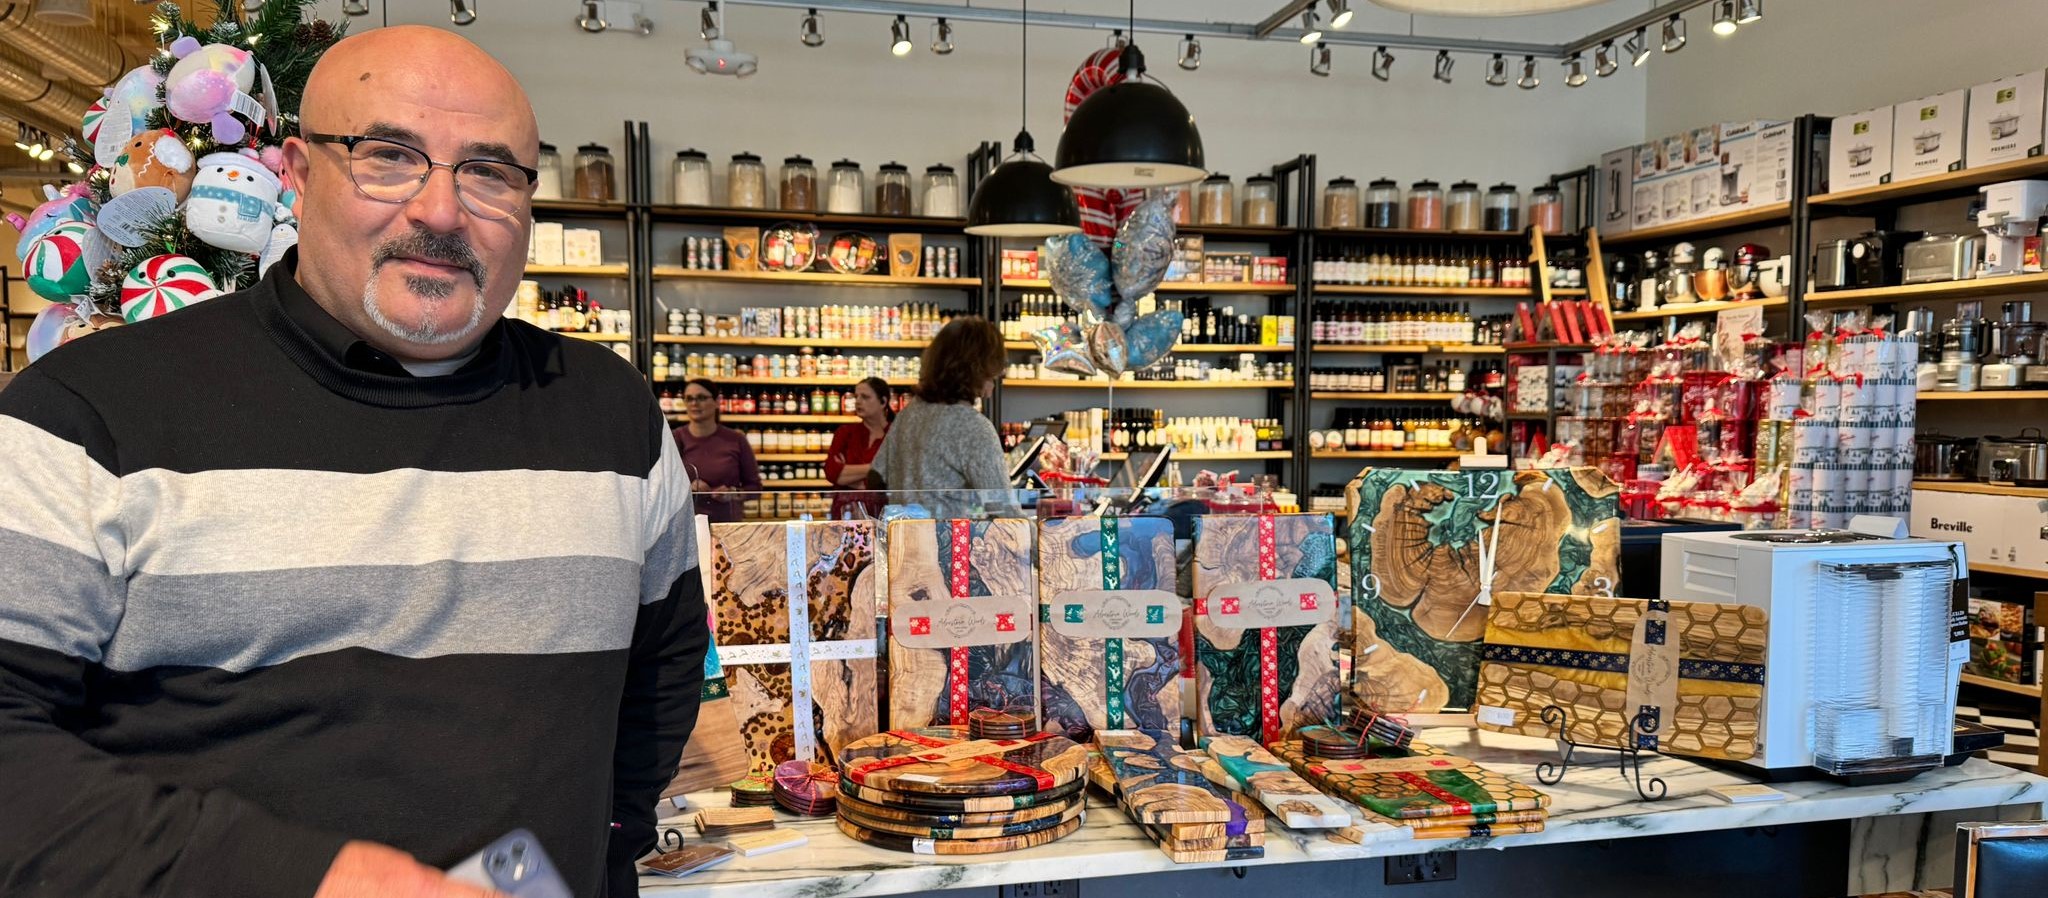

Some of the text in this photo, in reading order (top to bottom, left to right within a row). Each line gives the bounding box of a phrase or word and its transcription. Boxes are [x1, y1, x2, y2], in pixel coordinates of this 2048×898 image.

[1726, 124, 1750, 138] Cuisinart
[1763, 128, 1786, 140] Cuisinart
[1463, 472, 1501, 500] 12
[1930, 517, 1973, 533] Breville
[1361, 573, 1382, 600] 9
[1594, 576, 1614, 597] 3
